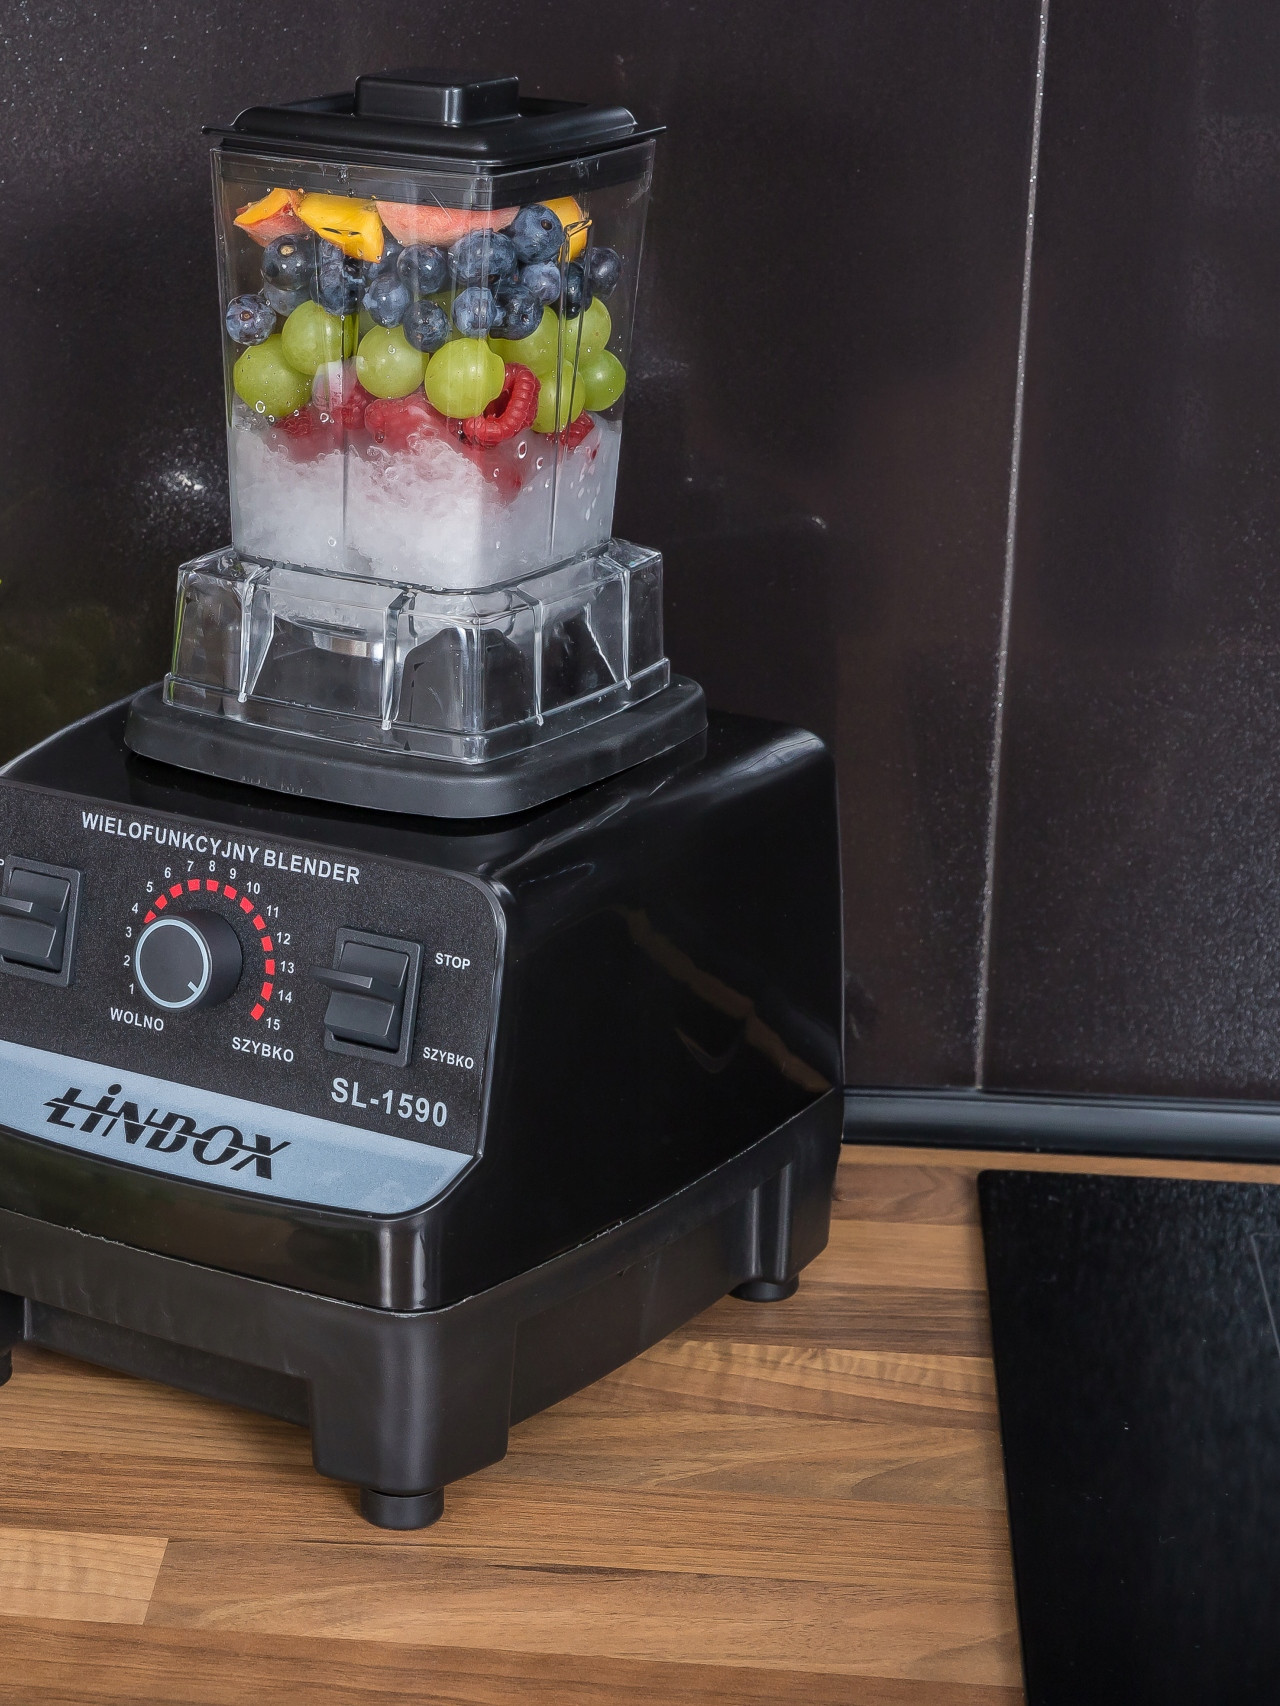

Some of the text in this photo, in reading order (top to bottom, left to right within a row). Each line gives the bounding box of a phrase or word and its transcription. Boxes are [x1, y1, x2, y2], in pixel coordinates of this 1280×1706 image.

[81, 811, 360, 885] WIELOFUNKCYJNY BLENDER
[164, 866, 172, 879] 6
[187, 859, 195, 872] 7
[208, 859, 216, 872] 8
[229, 867, 237, 880] 9
[145, 880, 154, 893] 5
[246, 881, 261, 895] 10
[131, 902, 139, 914] 4
[266, 904, 279, 919] 11
[125, 926, 132, 938] 3
[276, 931, 291, 946] 12
[123, 954, 131, 967] 2
[280, 960, 295, 974] 13
[435, 952, 471, 970] STOP
[128, 983, 134, 995] 1
[278, 989, 293, 1004] 14
[110, 1006, 164, 1031] WOLNO
[265, 1016, 281, 1031] 15
[231, 1036, 294, 1063] SZYBKO
[422, 1046, 475, 1070] SZYBKO
[331, 1077, 449, 1127] SL-1590
